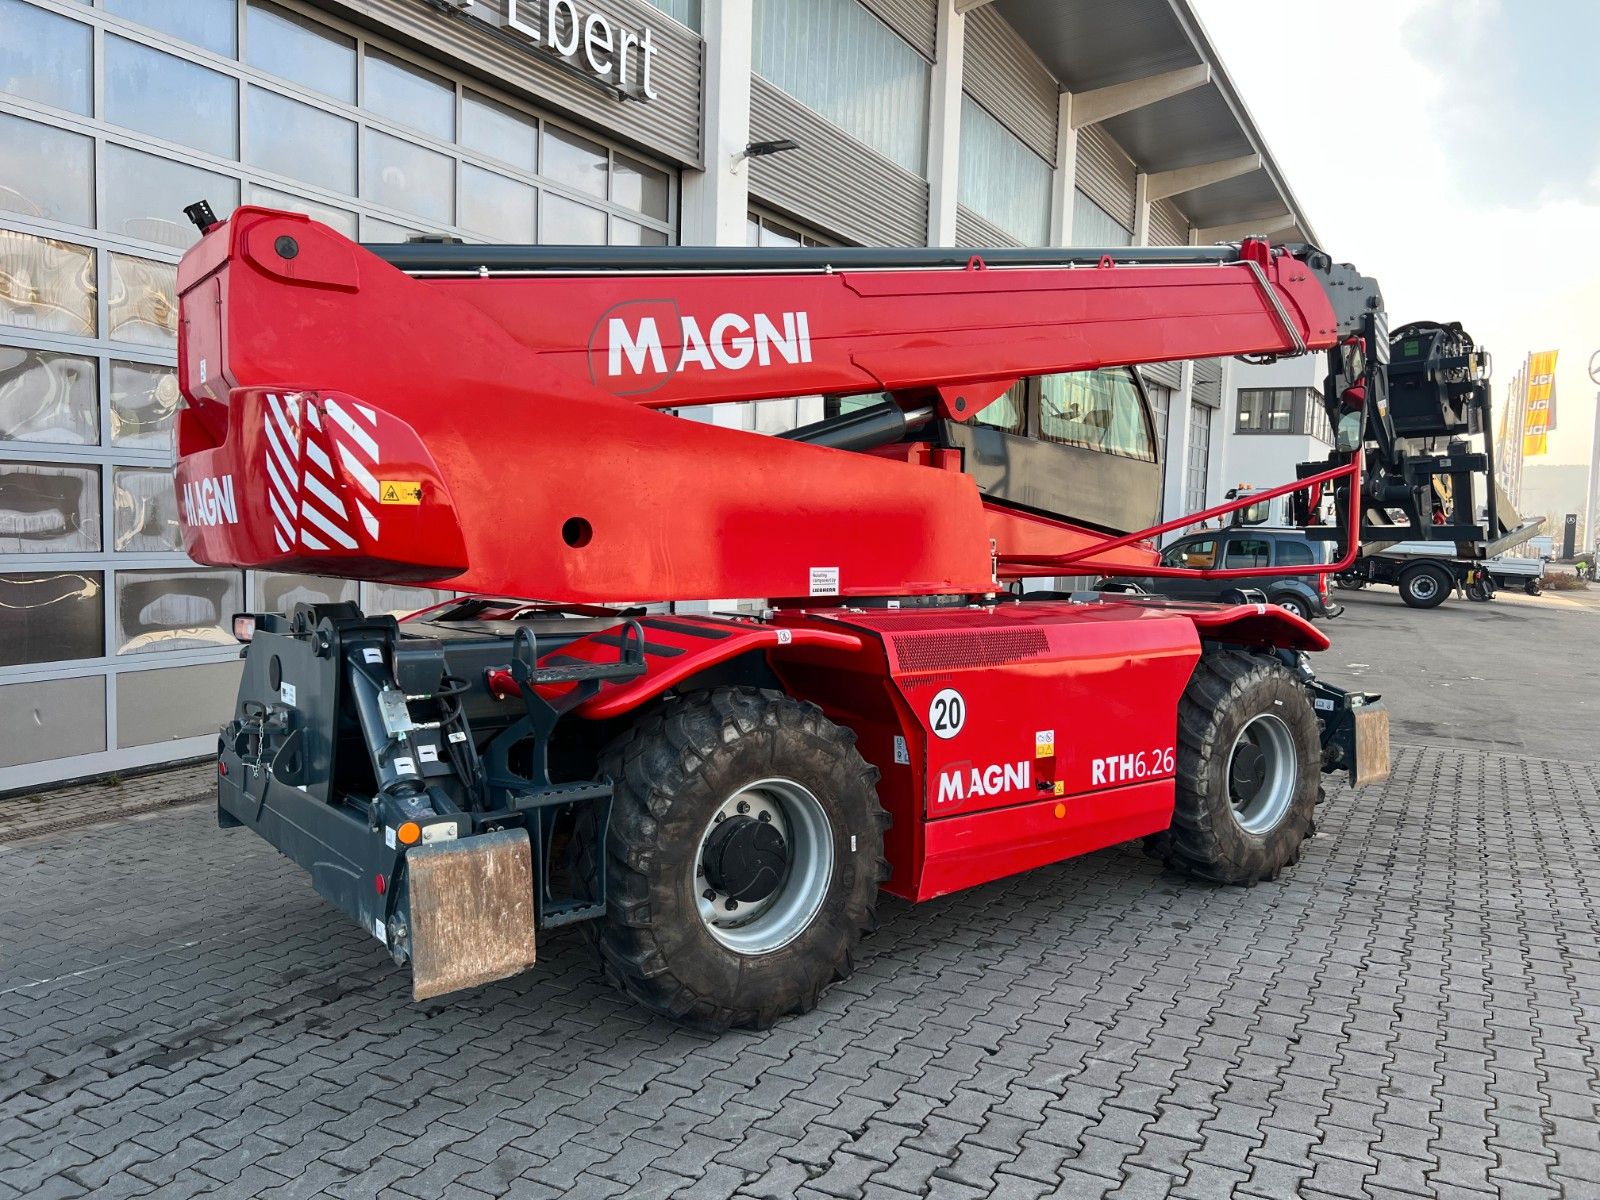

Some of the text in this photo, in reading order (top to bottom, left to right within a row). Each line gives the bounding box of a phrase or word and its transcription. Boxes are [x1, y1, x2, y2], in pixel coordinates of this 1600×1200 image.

[608, 312, 812, 376] MAGNI
[183, 474, 238, 527] MAGNI
[935, 697, 961, 731] 20
[937, 760, 1029, 803] MAGNI
[1092, 747, 1175, 785] RTH6.26
